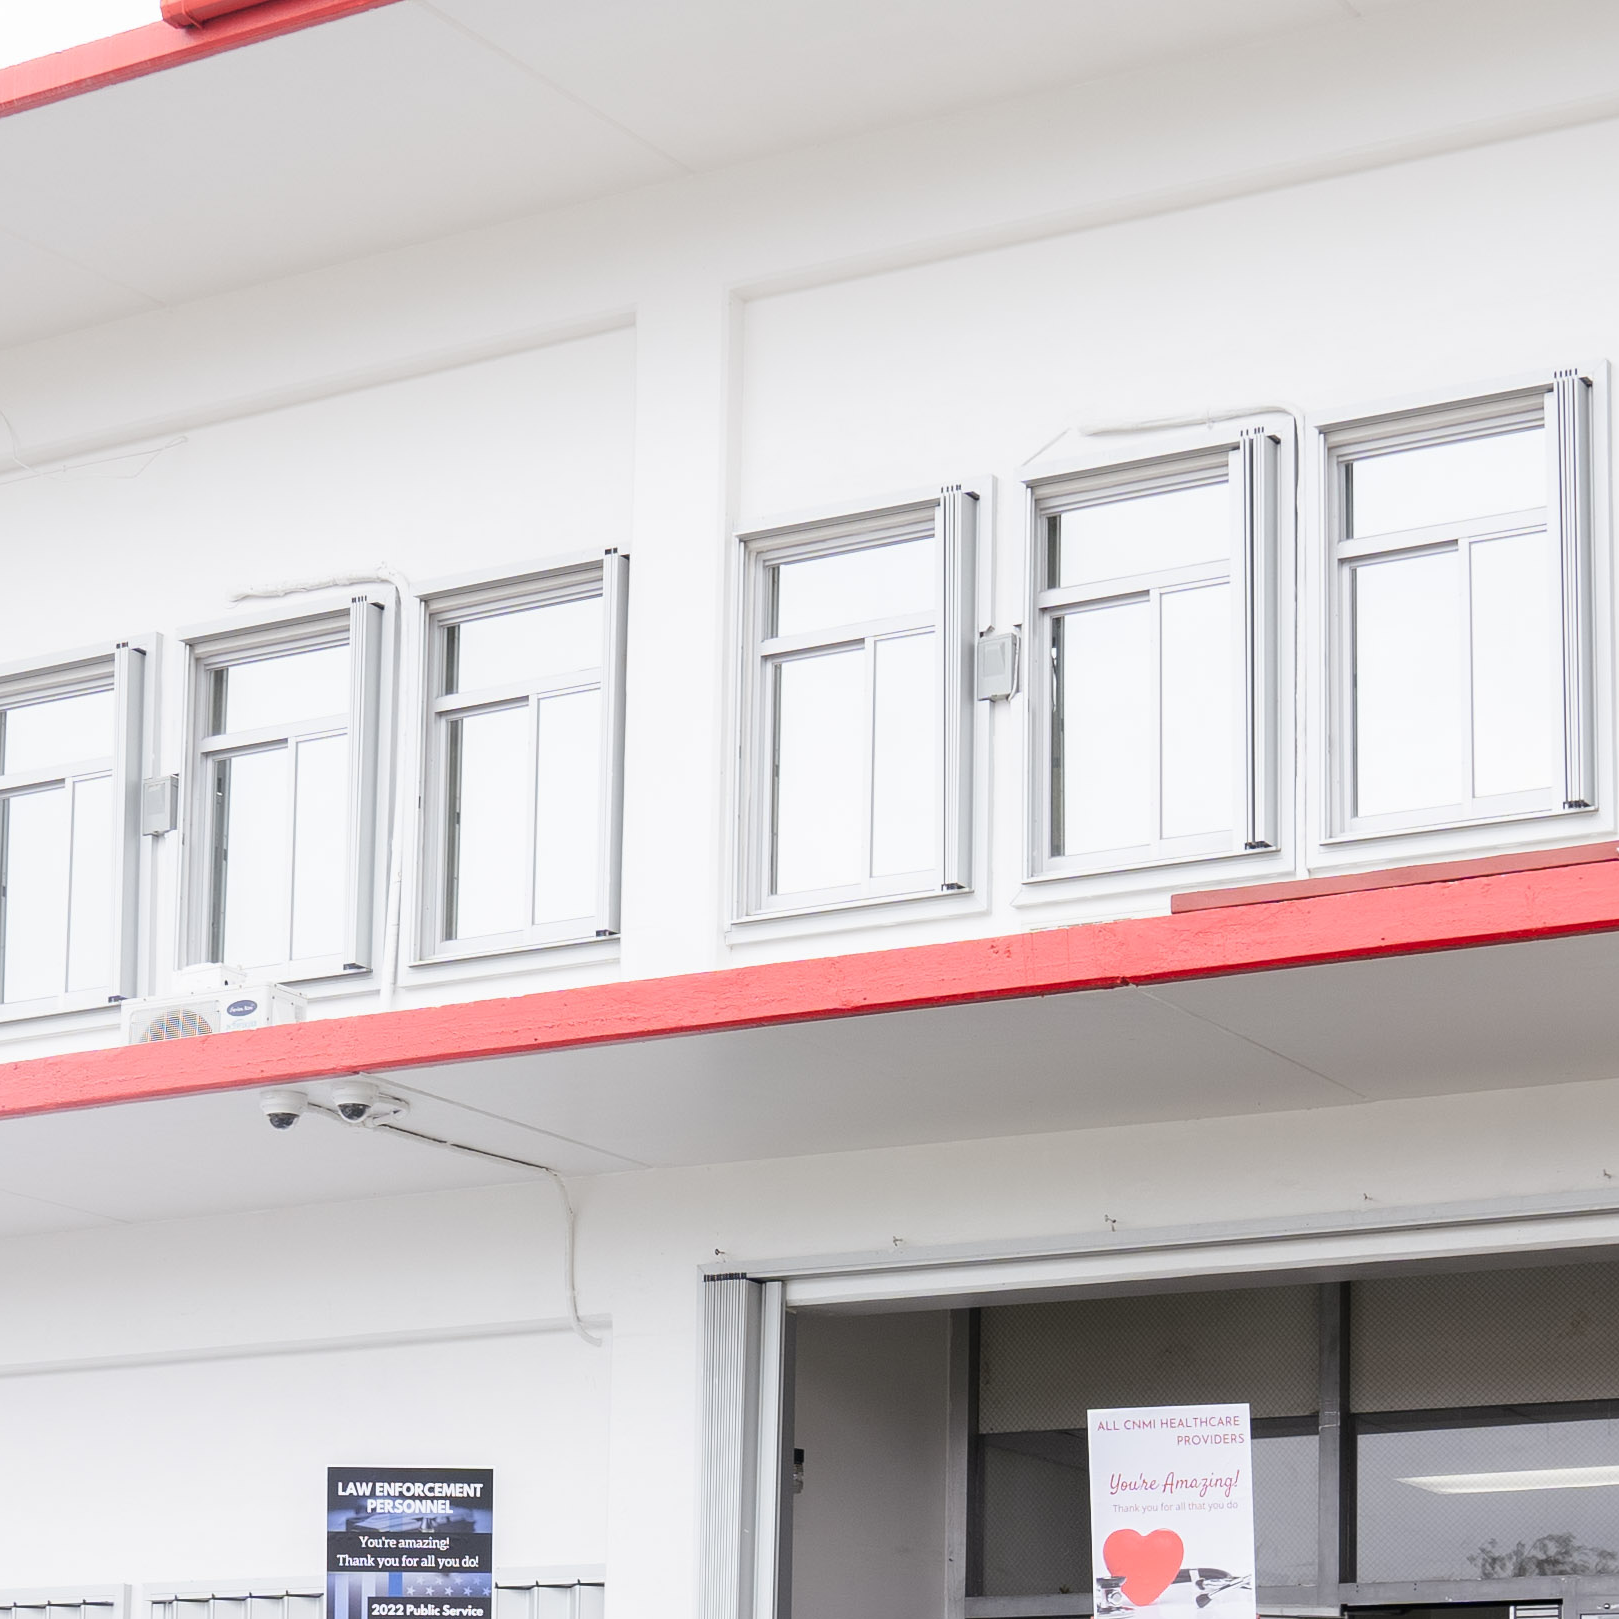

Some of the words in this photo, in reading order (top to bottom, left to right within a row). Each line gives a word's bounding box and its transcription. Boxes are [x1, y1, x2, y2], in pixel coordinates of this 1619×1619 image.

[1097, 1420, 1119, 1431] ALL
[1123, 1418, 1157, 1430] CNMI
[1160, 1416, 1240, 1429] HEALTHCARE
[1177, 1433, 1245, 1446] PROVIDERS
[337, 1481, 372, 1496] LAW
[375, 1482, 483, 1498] ENFORCEMENT
[1109, 1473, 1159, 1495] You're
[1161, 1469, 1240, 1497] Amazing!
[367, 1499, 454, 1514] PERSONNEL
[1113, 1503, 1140, 1513] Thank
[1141, 1505, 1158, 1515] you
[1160, 1503, 1173, 1512] for
[1174, 1502, 1186, 1511] all
[1187, 1501, 1205, 1511] that
[1206, 1503, 1224, 1513] you
[1226, 1500, 1239, 1510] do
[359, 1535, 397, 1549] You're
[398, 1536, 450, 1551] amazing!
[337, 1554, 375, 1567] Thank
[377, 1557, 399, 1570] you
[402, 1555, 420, 1567] for
[421, 1555, 436, 1568] all
[437, 1558, 460, 1571] you
[462, 1555, 479, 1568] do!
[371, 1603, 404, 1616] 2022
[406, 1604, 441, 1616] Public
[442, 1604, 484, 1617] Service
